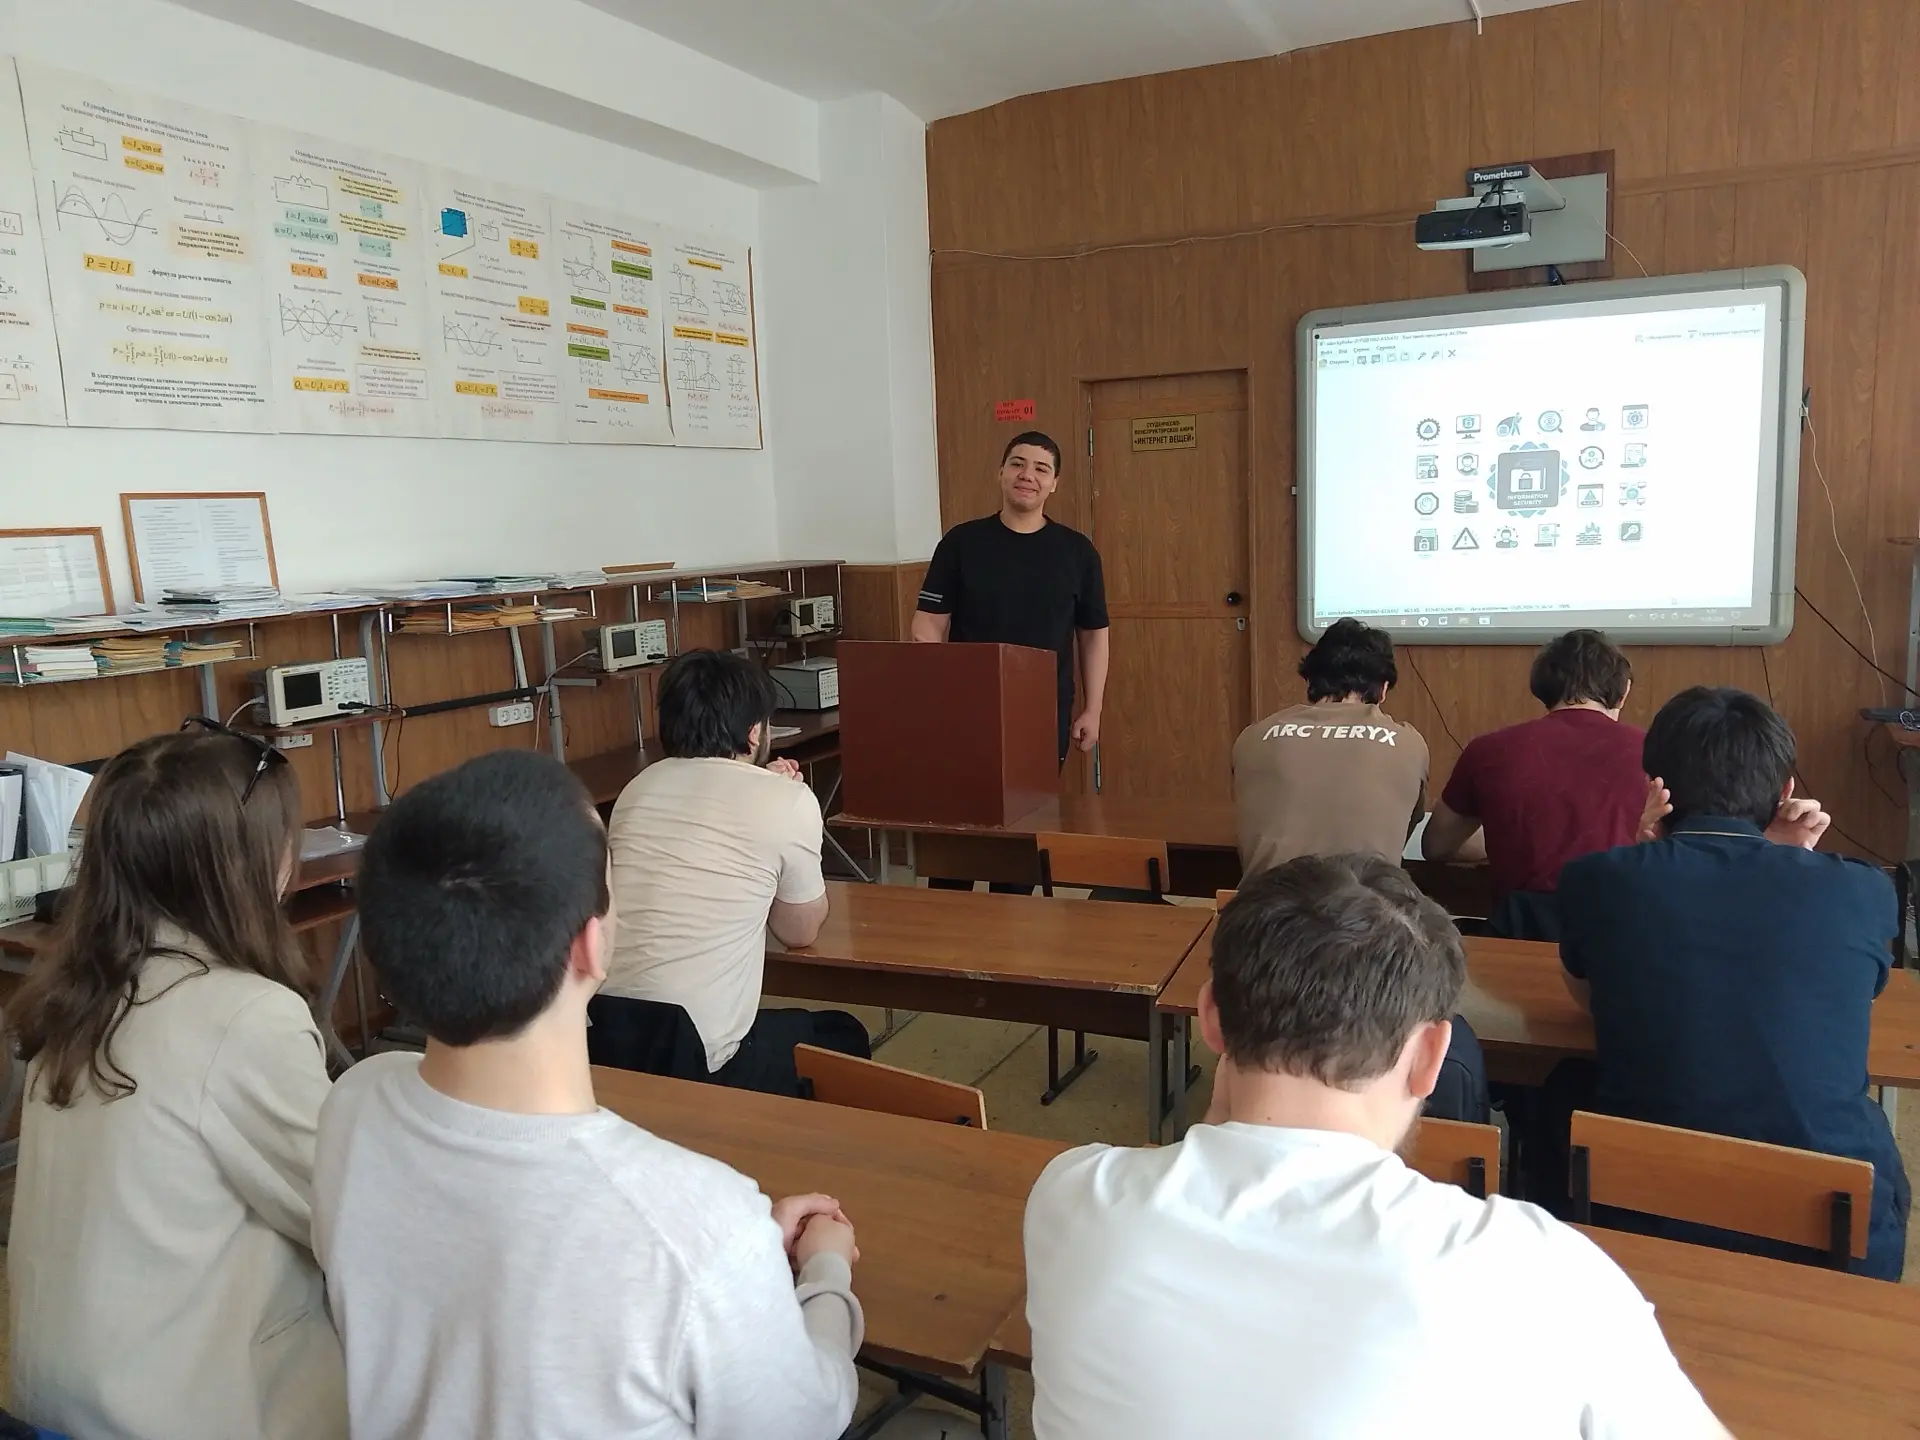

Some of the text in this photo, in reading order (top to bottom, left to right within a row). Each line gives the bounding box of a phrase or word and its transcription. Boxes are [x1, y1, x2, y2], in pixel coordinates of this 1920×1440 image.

[1474, 169, 1523, 182] Promethean
[86, 256, 95, 268] P
[110, 260, 119, 272] U
[1024, 405, 1033, 416] 01
[1507, 492, 1549, 501] INFORMATION
[1513, 498, 1542, 506] SECURITY
